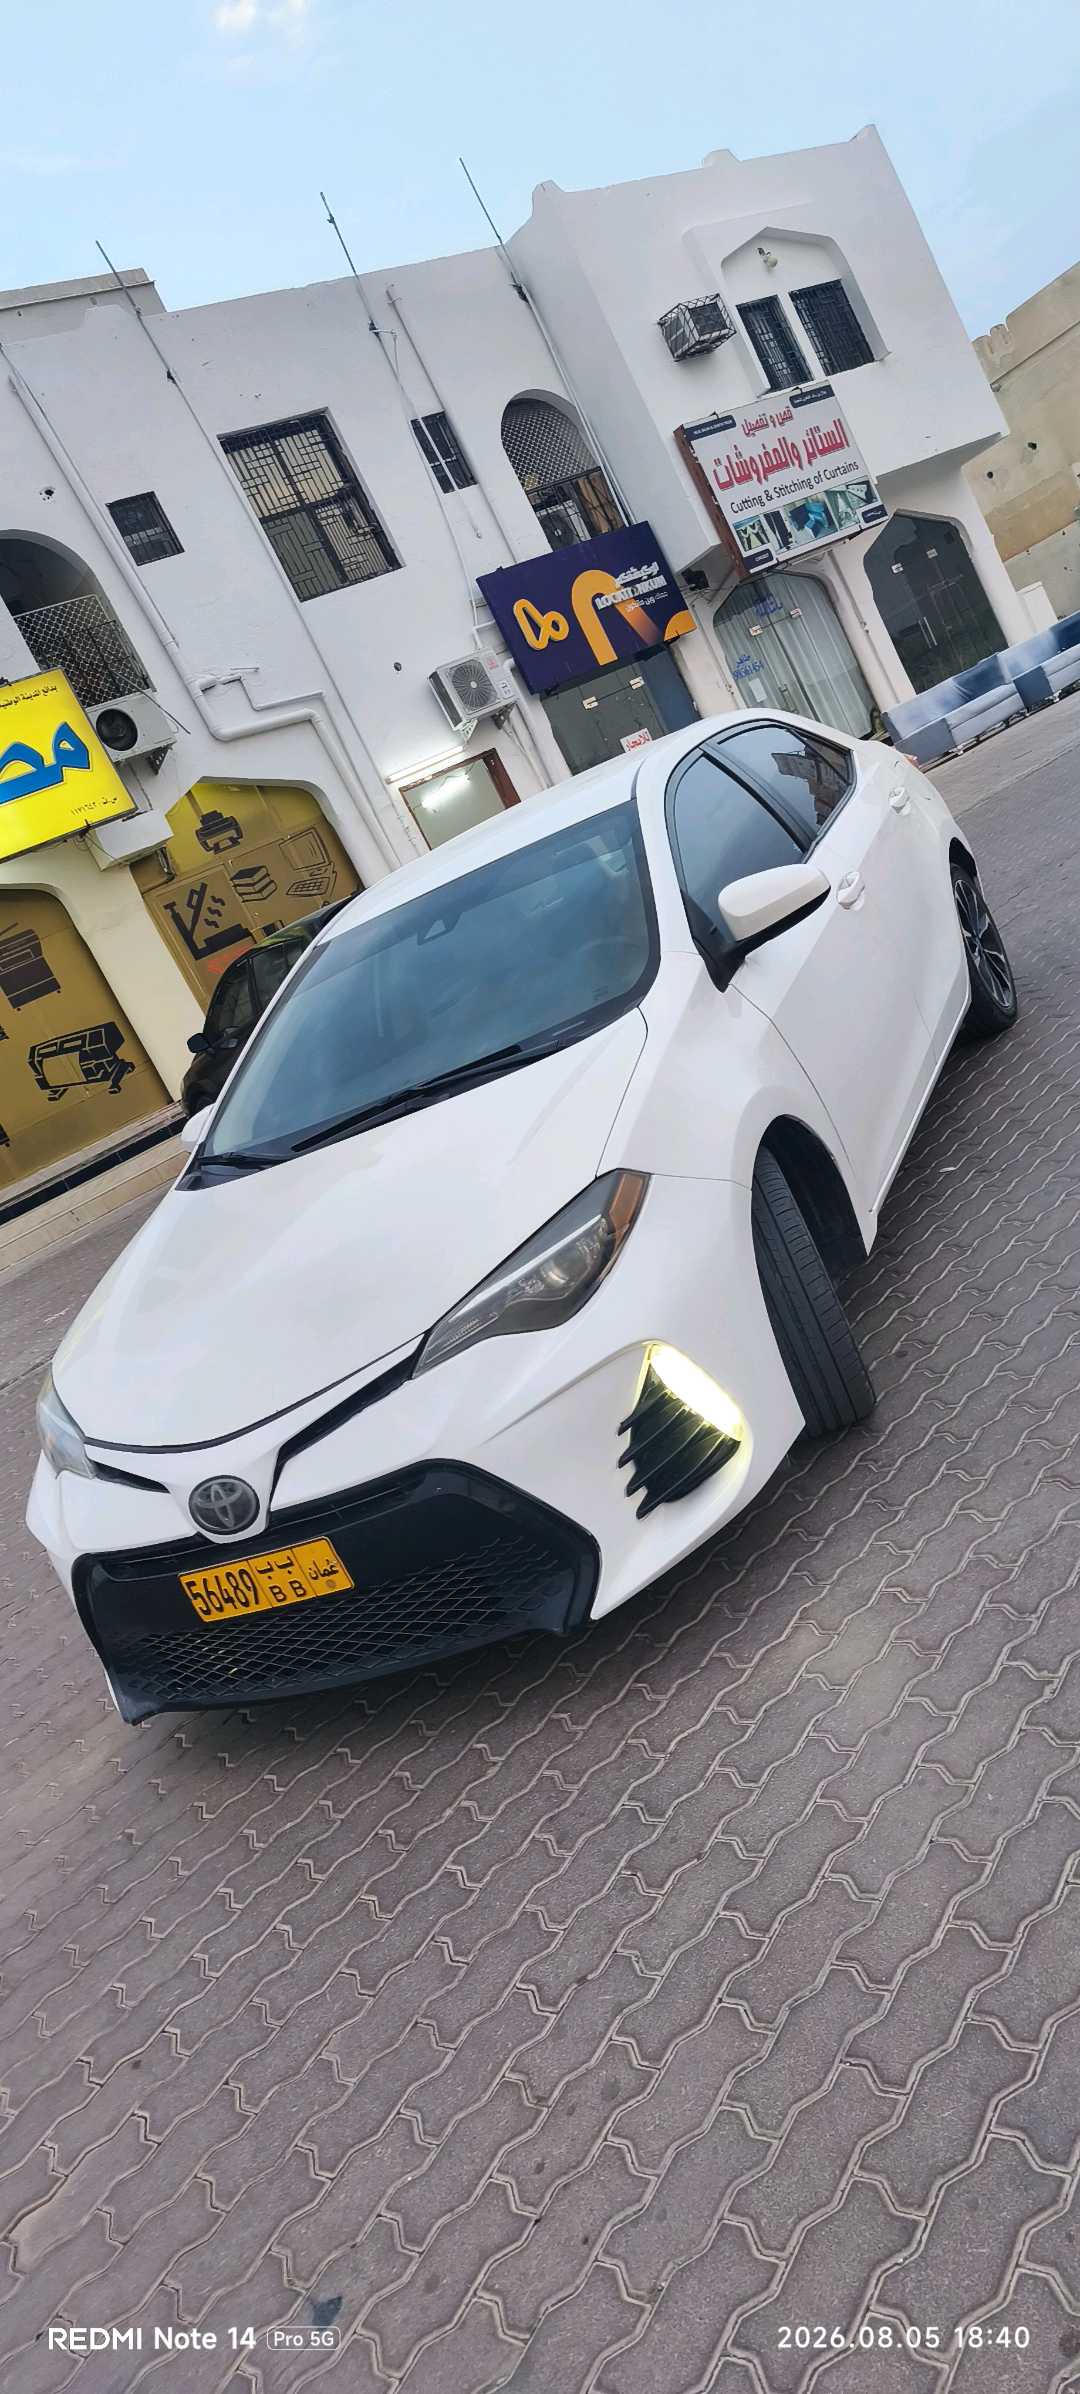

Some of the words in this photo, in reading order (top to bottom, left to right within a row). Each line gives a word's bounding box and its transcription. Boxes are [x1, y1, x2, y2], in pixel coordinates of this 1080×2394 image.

[741, 413, 769, 437] تفصيل
[769, 416, 777, 428] و
[777, 406, 793, 427] قص
[802, 418, 850, 466] الستائر
[712, 436, 803, 491] والمفروشات
[730, 492, 766, 514] Cutting
[764, 490, 775, 502] &
[773, 476, 815, 500] Stitching
[814, 470, 825, 485] of
[823, 460, 859, 481] Curtains
[0, 696, 21, 710] الوطني
[185, 1568, 260, 1616] 56489
[269, 1585, 287, 1603] B
[288, 1579, 307, 1598] B
